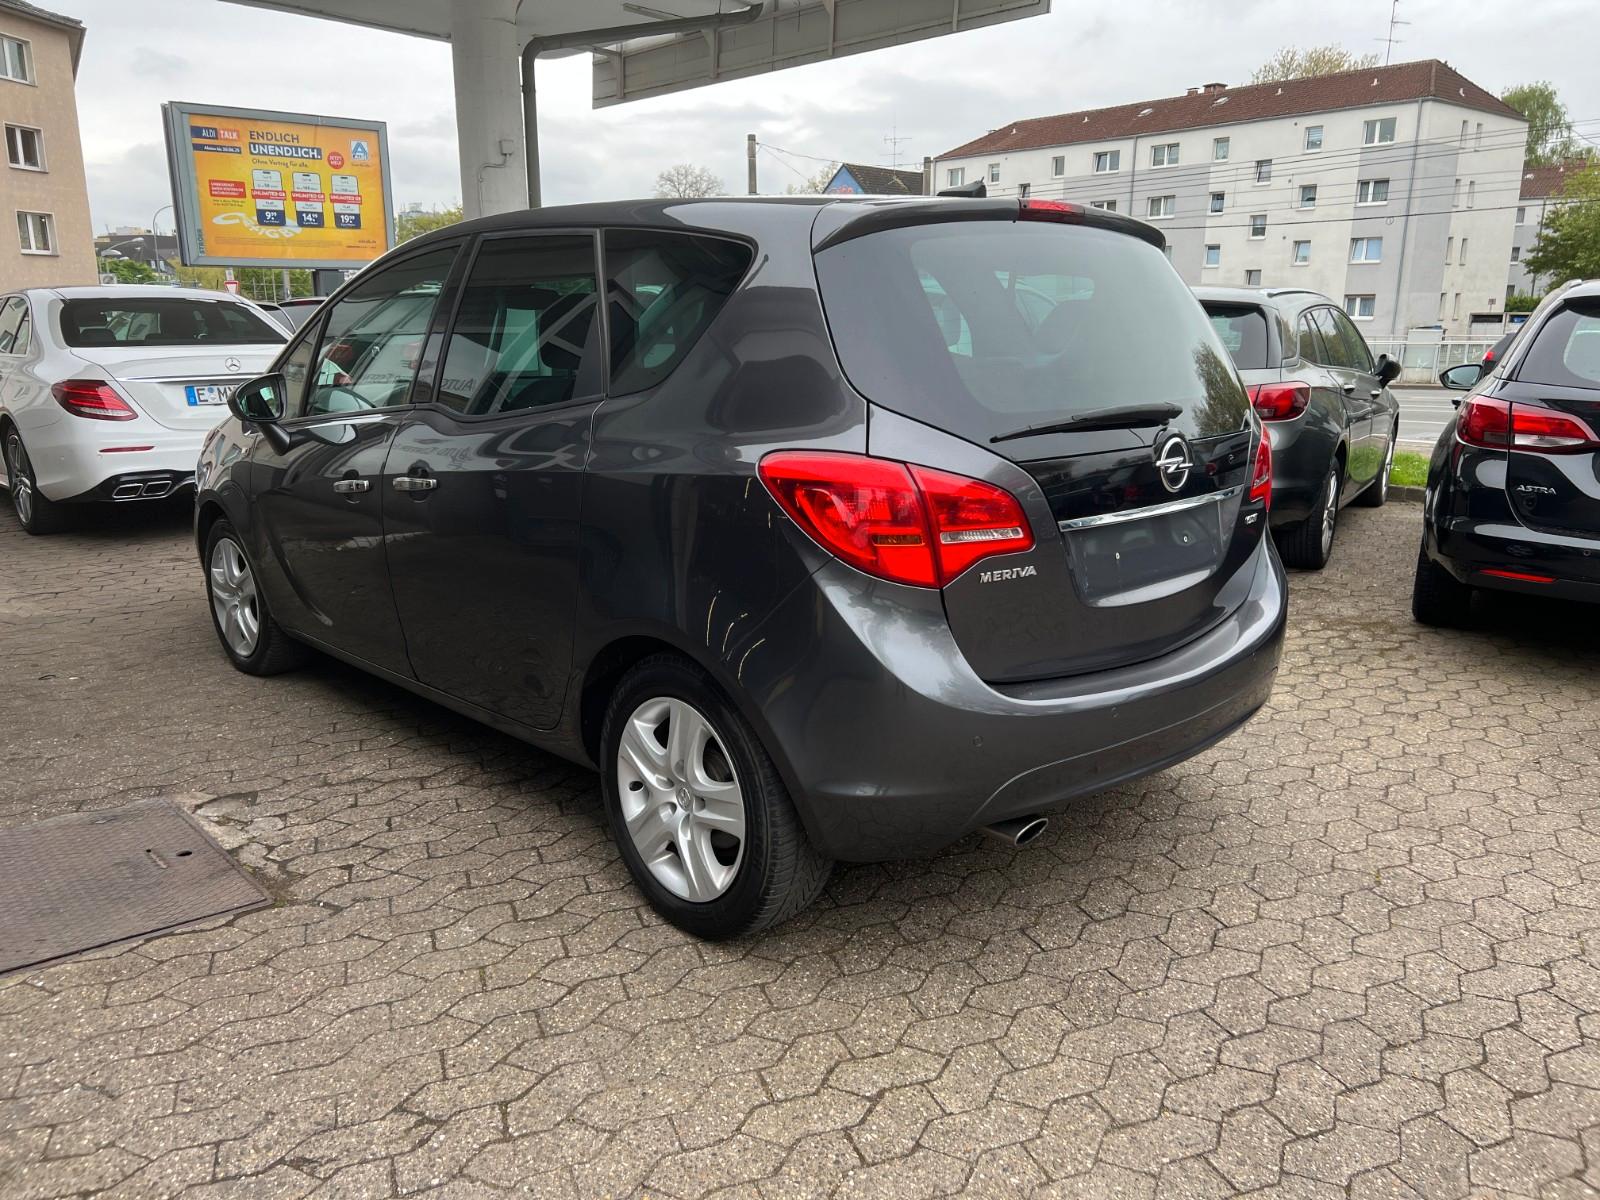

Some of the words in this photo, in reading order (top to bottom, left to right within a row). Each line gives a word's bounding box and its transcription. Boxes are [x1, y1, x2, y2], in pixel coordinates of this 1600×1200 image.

[202, 128, 216, 138] ALDI
[220, 130, 237, 140] TALK
[249, 130, 300, 143] ENDLICH
[250, 143, 321, 159] UNENDLICH.
[196, 388, 209, 403] E
[1516, 484, 1557, 495] ASTRA
[979, 565, 1037, 584] MERIVA
